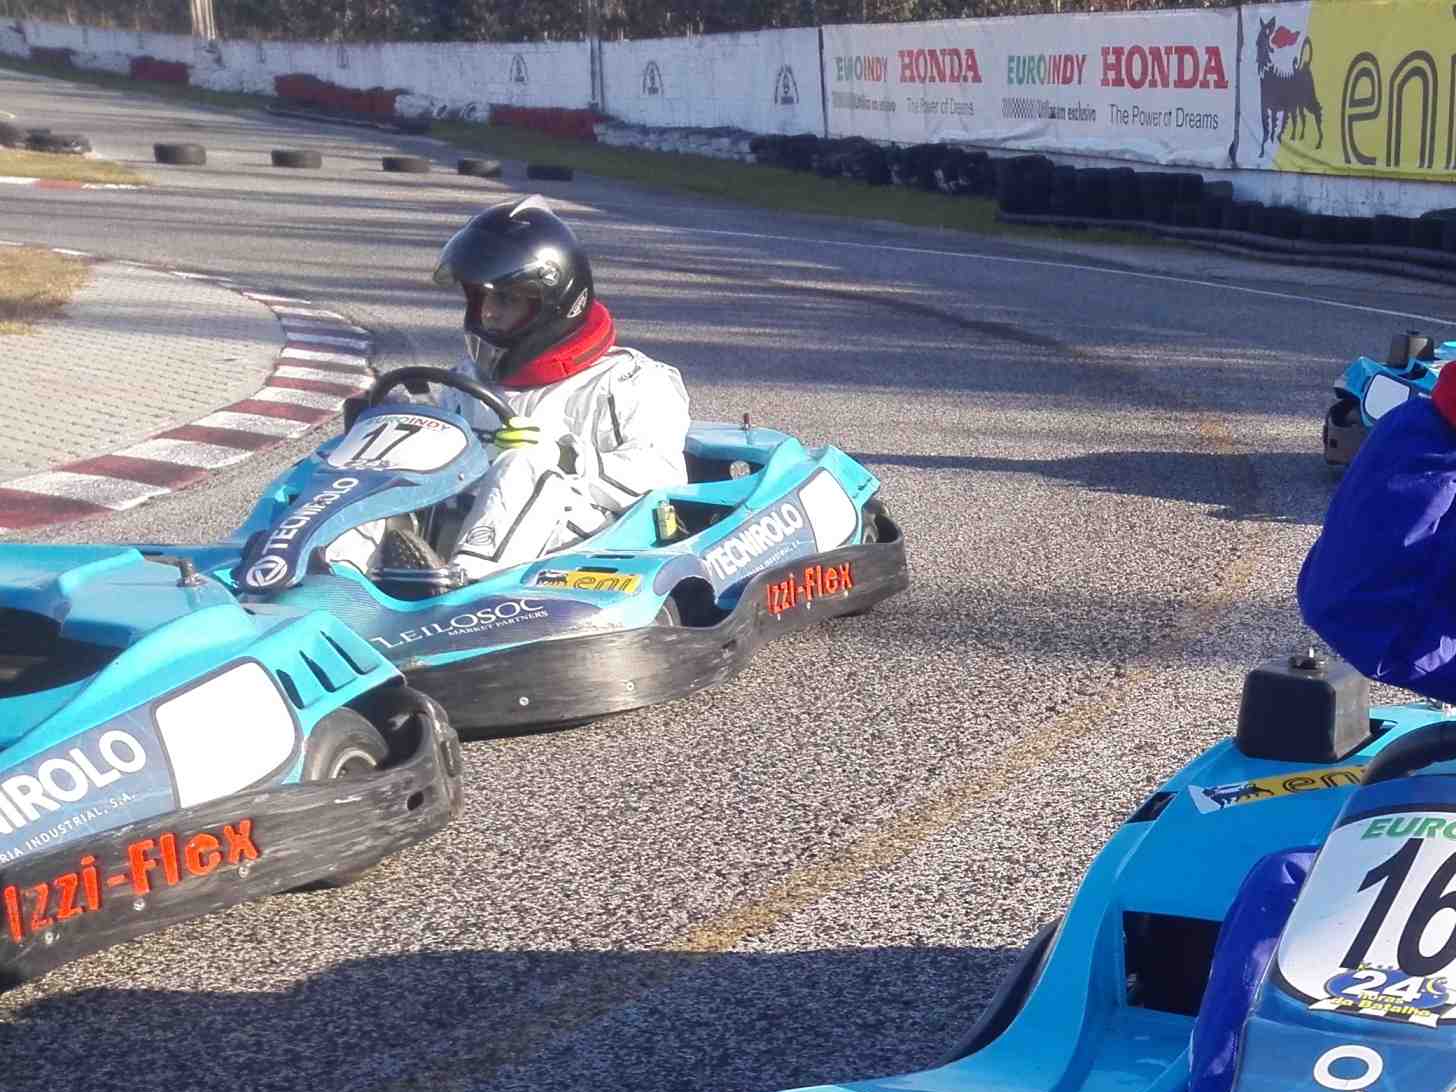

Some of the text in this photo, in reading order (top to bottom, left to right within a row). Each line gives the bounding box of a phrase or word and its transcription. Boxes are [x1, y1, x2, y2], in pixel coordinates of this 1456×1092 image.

[897, 48, 982, 83] HONDA
[1007, 54, 1087, 85] EUROINDY
[1100, 45, 1229, 89] HONDA
[1110, 104, 1128, 124] The
[1131, 105, 1158, 127] Power
[1175, 107, 1219, 130] Dreams
[352, 422, 423, 460] 17
[370, 600, 544, 649] LEILOSOC
[1341, 970, 1425, 1002] 24
